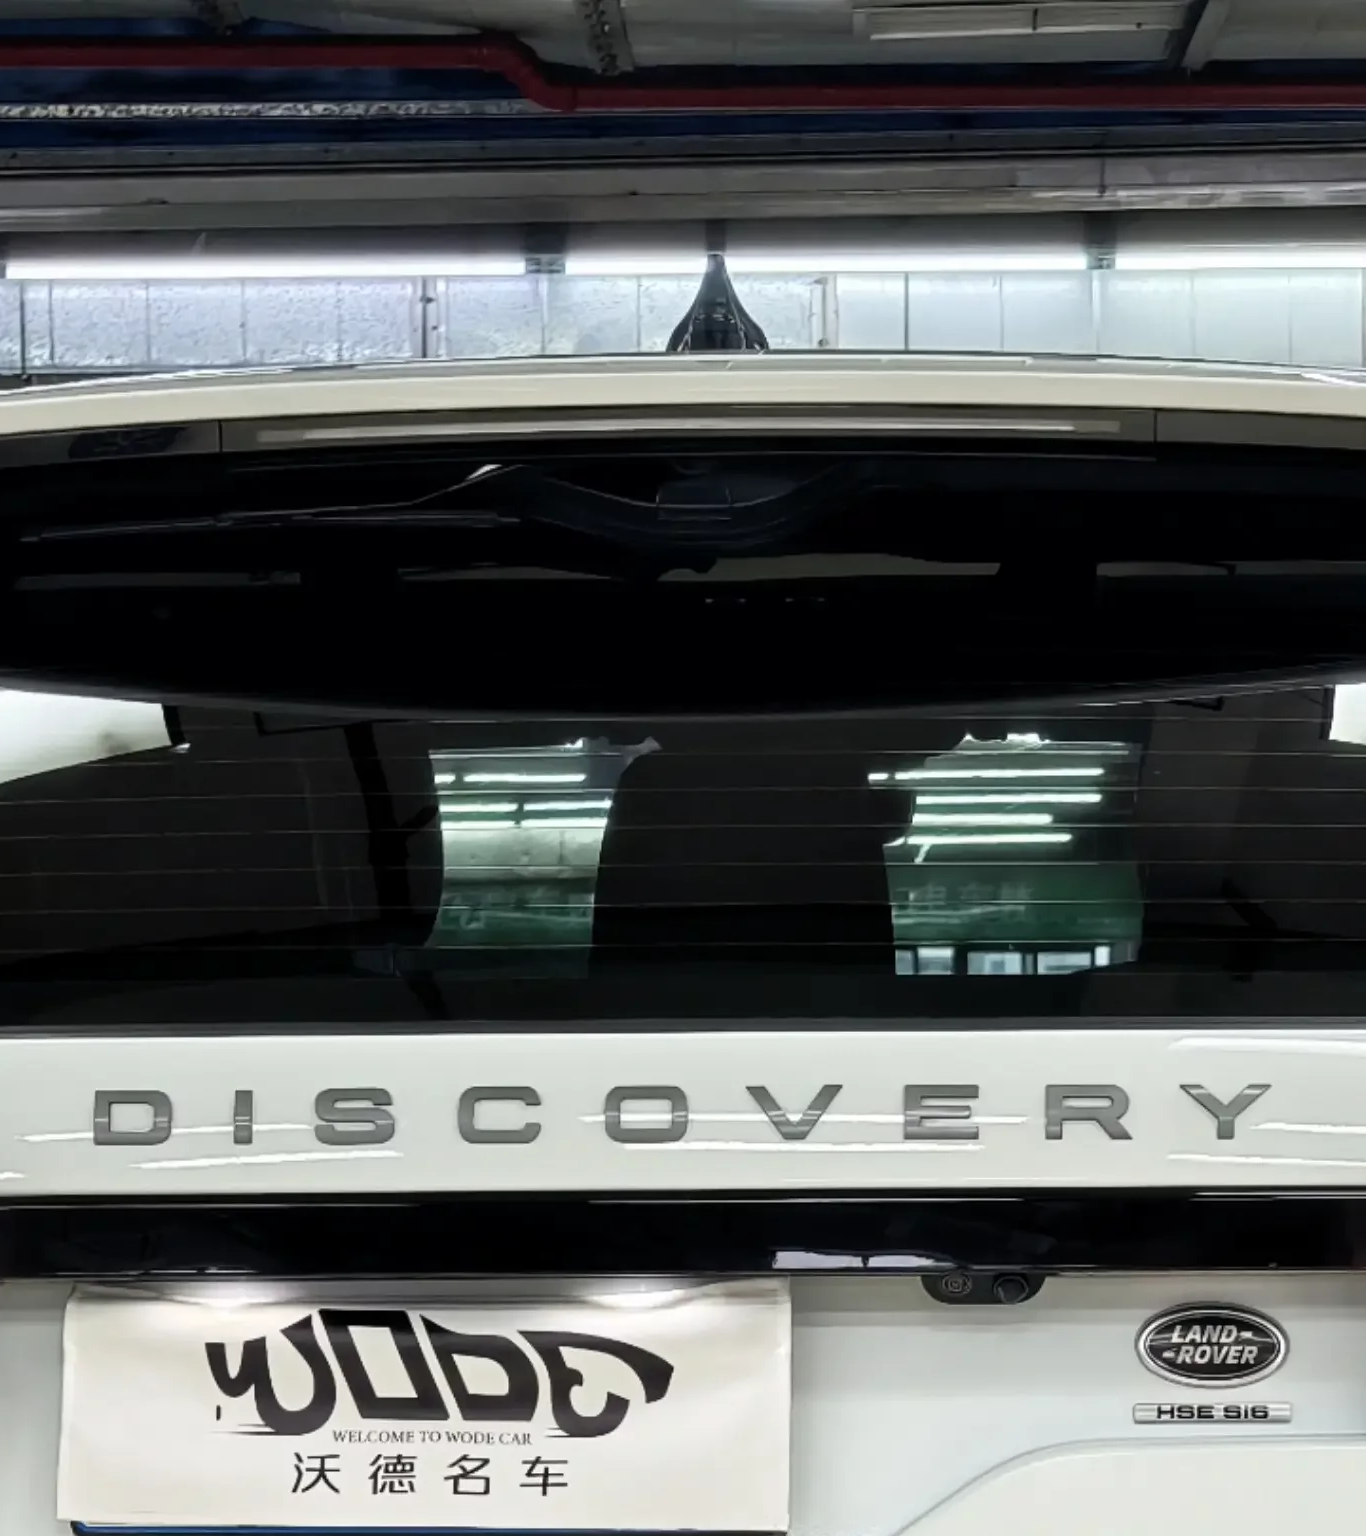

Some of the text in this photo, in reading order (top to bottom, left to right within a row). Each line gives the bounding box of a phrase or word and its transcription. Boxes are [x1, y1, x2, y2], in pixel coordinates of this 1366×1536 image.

[93, 1083, 1272, 1147] DISCOVERY
[1170, 1324, 1238, 1344] LAND
[1176, 1345, 1259, 1365] ROVER
[1156, 1405, 1215, 1420] HSE
[332, 1429, 533, 1446] WELCOME TO WODE CAR
[290, 1451, 569, 1497] 沃德名车
